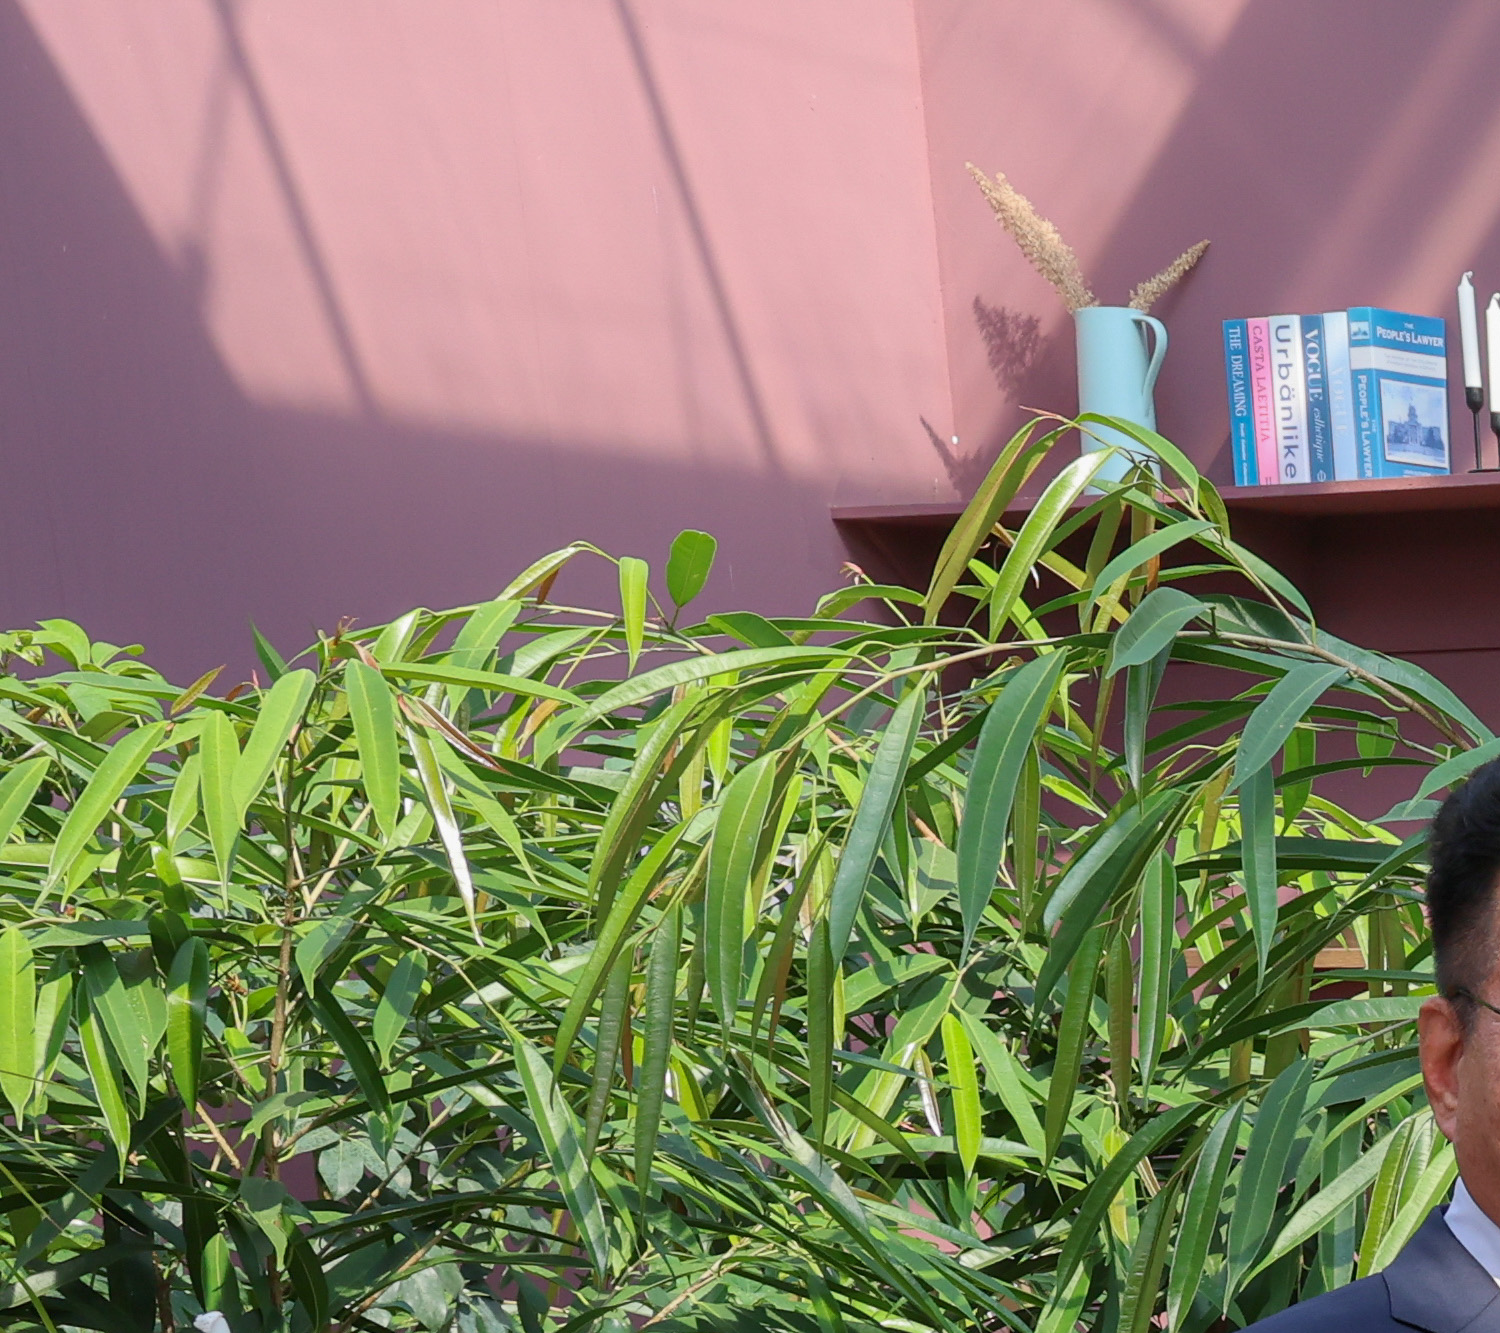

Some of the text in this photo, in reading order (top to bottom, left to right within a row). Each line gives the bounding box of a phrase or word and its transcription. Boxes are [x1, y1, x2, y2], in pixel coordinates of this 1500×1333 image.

[1228, 326, 1242, 351] THE
[1305, 328, 1322, 401] VOGUE
[1412, 332, 1444, 347] LAWYER
[1230, 353, 1246, 417] DREAMING
[1252, 325, 1270, 442] CASTA LAETITIA
[1275, 325, 1297, 479] Urbänlike
[1357, 375, 1373, 478] PEOPLE'S LAWYER
